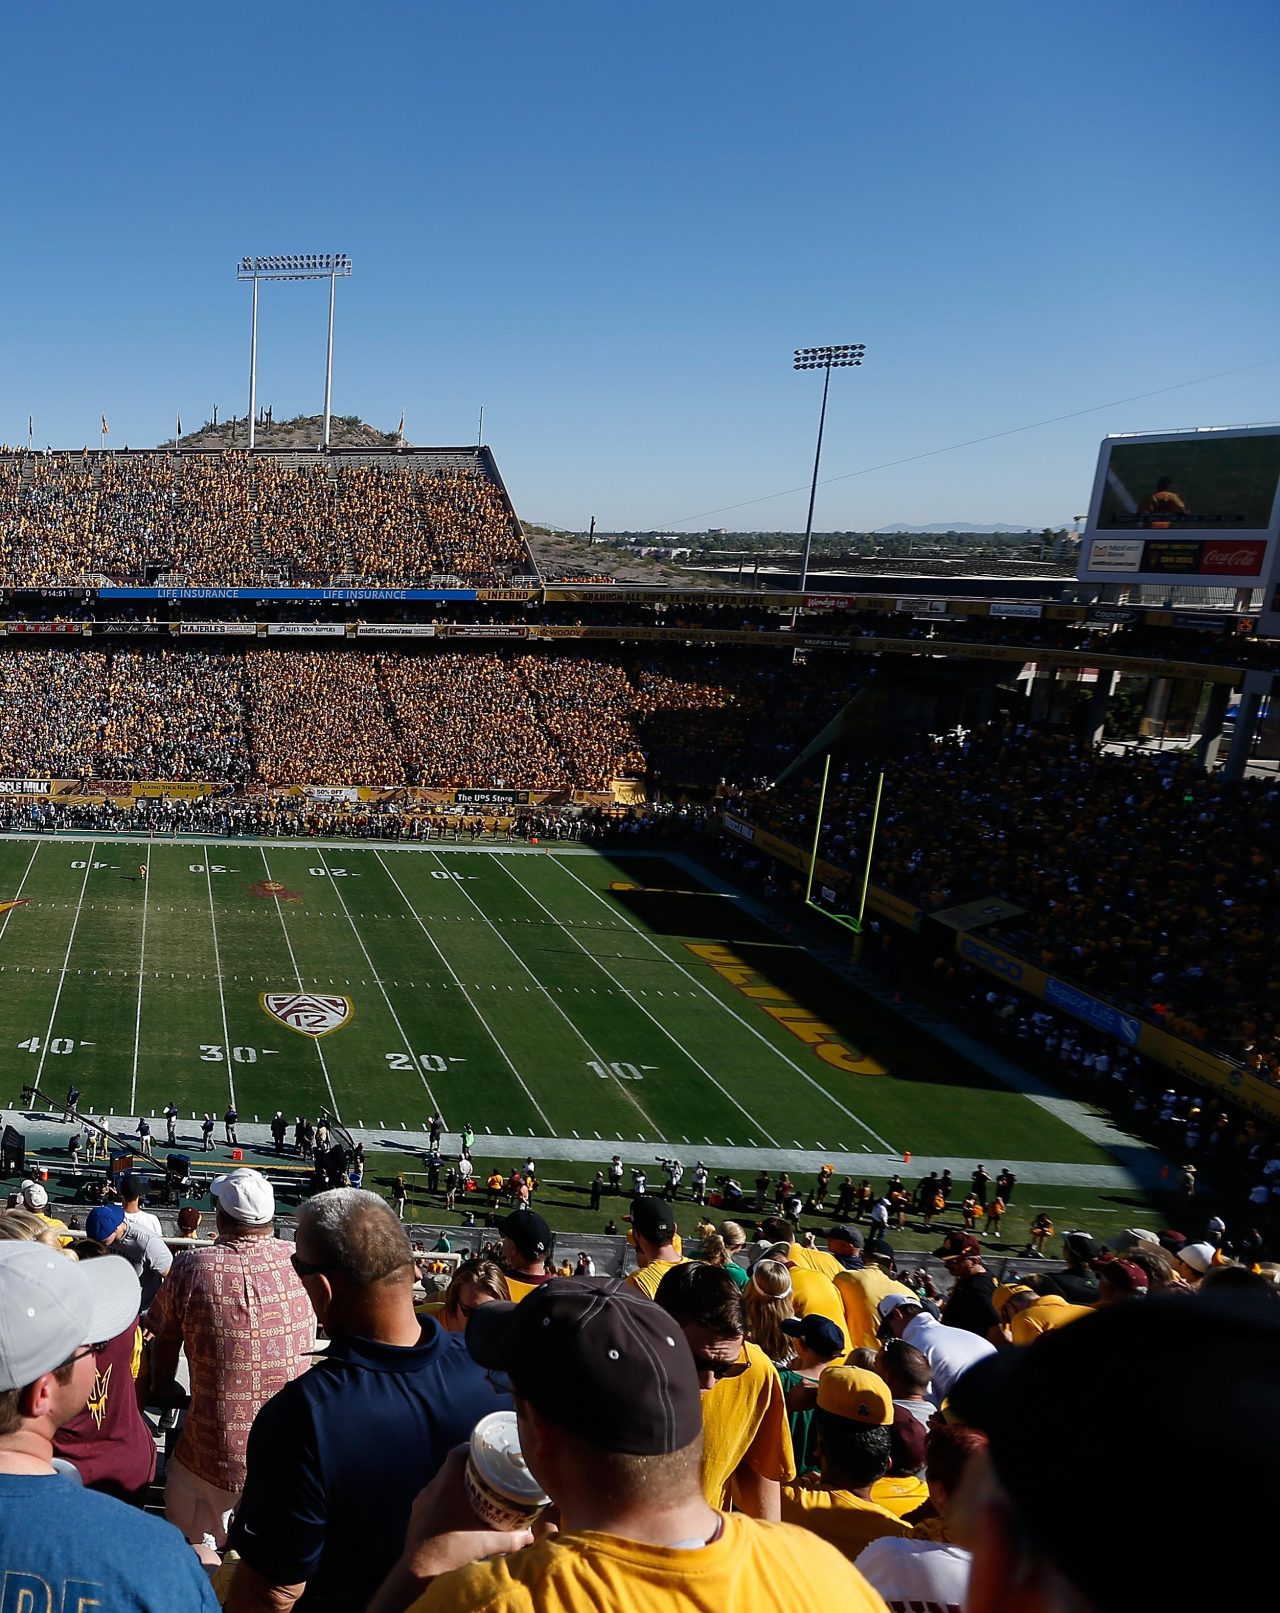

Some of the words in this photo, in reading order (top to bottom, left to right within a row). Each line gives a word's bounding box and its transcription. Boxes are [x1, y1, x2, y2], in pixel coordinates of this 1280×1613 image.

[157, 589, 178, 598] LIFE
[180, 589, 239, 598] INSURANCE
[323, 590, 343, 599] LIFE
[346, 590, 406, 599] INSURANCE
[487, 591, 529, 600] INFERNO
[991, 606, 1040, 616] bluemedia
[181, 625, 226, 633] MAJERLE'S
[550, 629, 581, 637] WOODY
[22, 780, 49, 793] MILK
[458, 793, 473, 801] The
[474, 793, 490, 802] UPS
[491, 794, 513, 803] Store
[960, 939, 1023, 981] GEICO
[294, 1014, 330, 1028] 12
[17, 1036, 76, 1055] 40
[200, 1044, 258, 1064] 30
[384, 1052, 449, 1072] 20
[586, 1060, 645, 1080] 10
